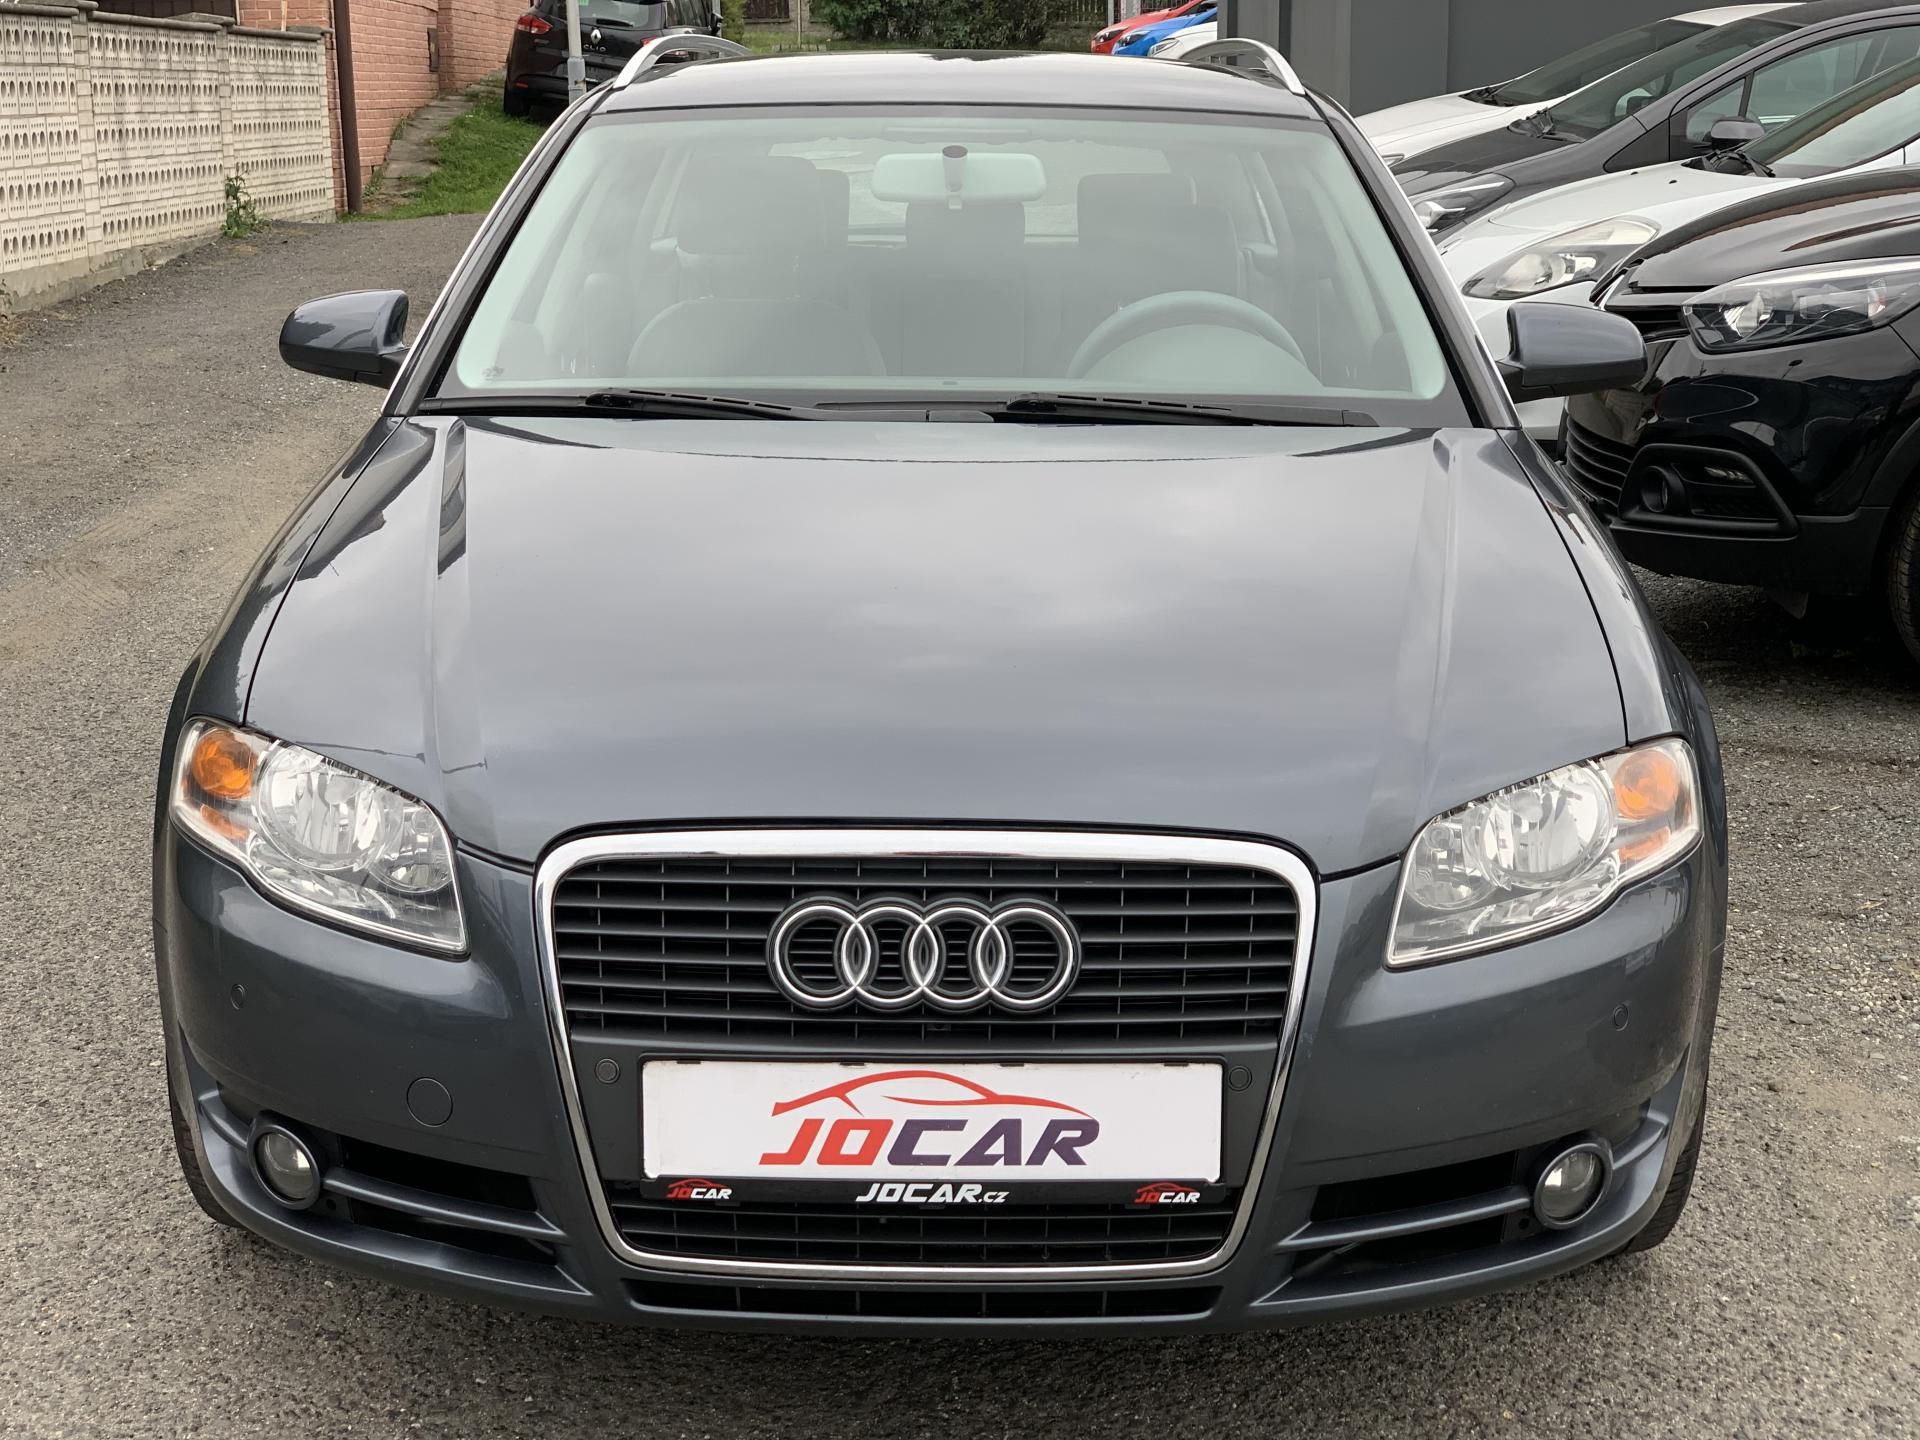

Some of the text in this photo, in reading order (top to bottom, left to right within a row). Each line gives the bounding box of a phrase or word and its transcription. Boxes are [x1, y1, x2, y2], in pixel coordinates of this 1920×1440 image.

[583, 43, 607, 51] CLIO
[758, 1118, 1101, 1166] JOCAR
[666, 1187, 733, 1200] JOCAR
[1134, 1191, 1201, 1204] JOCAR
